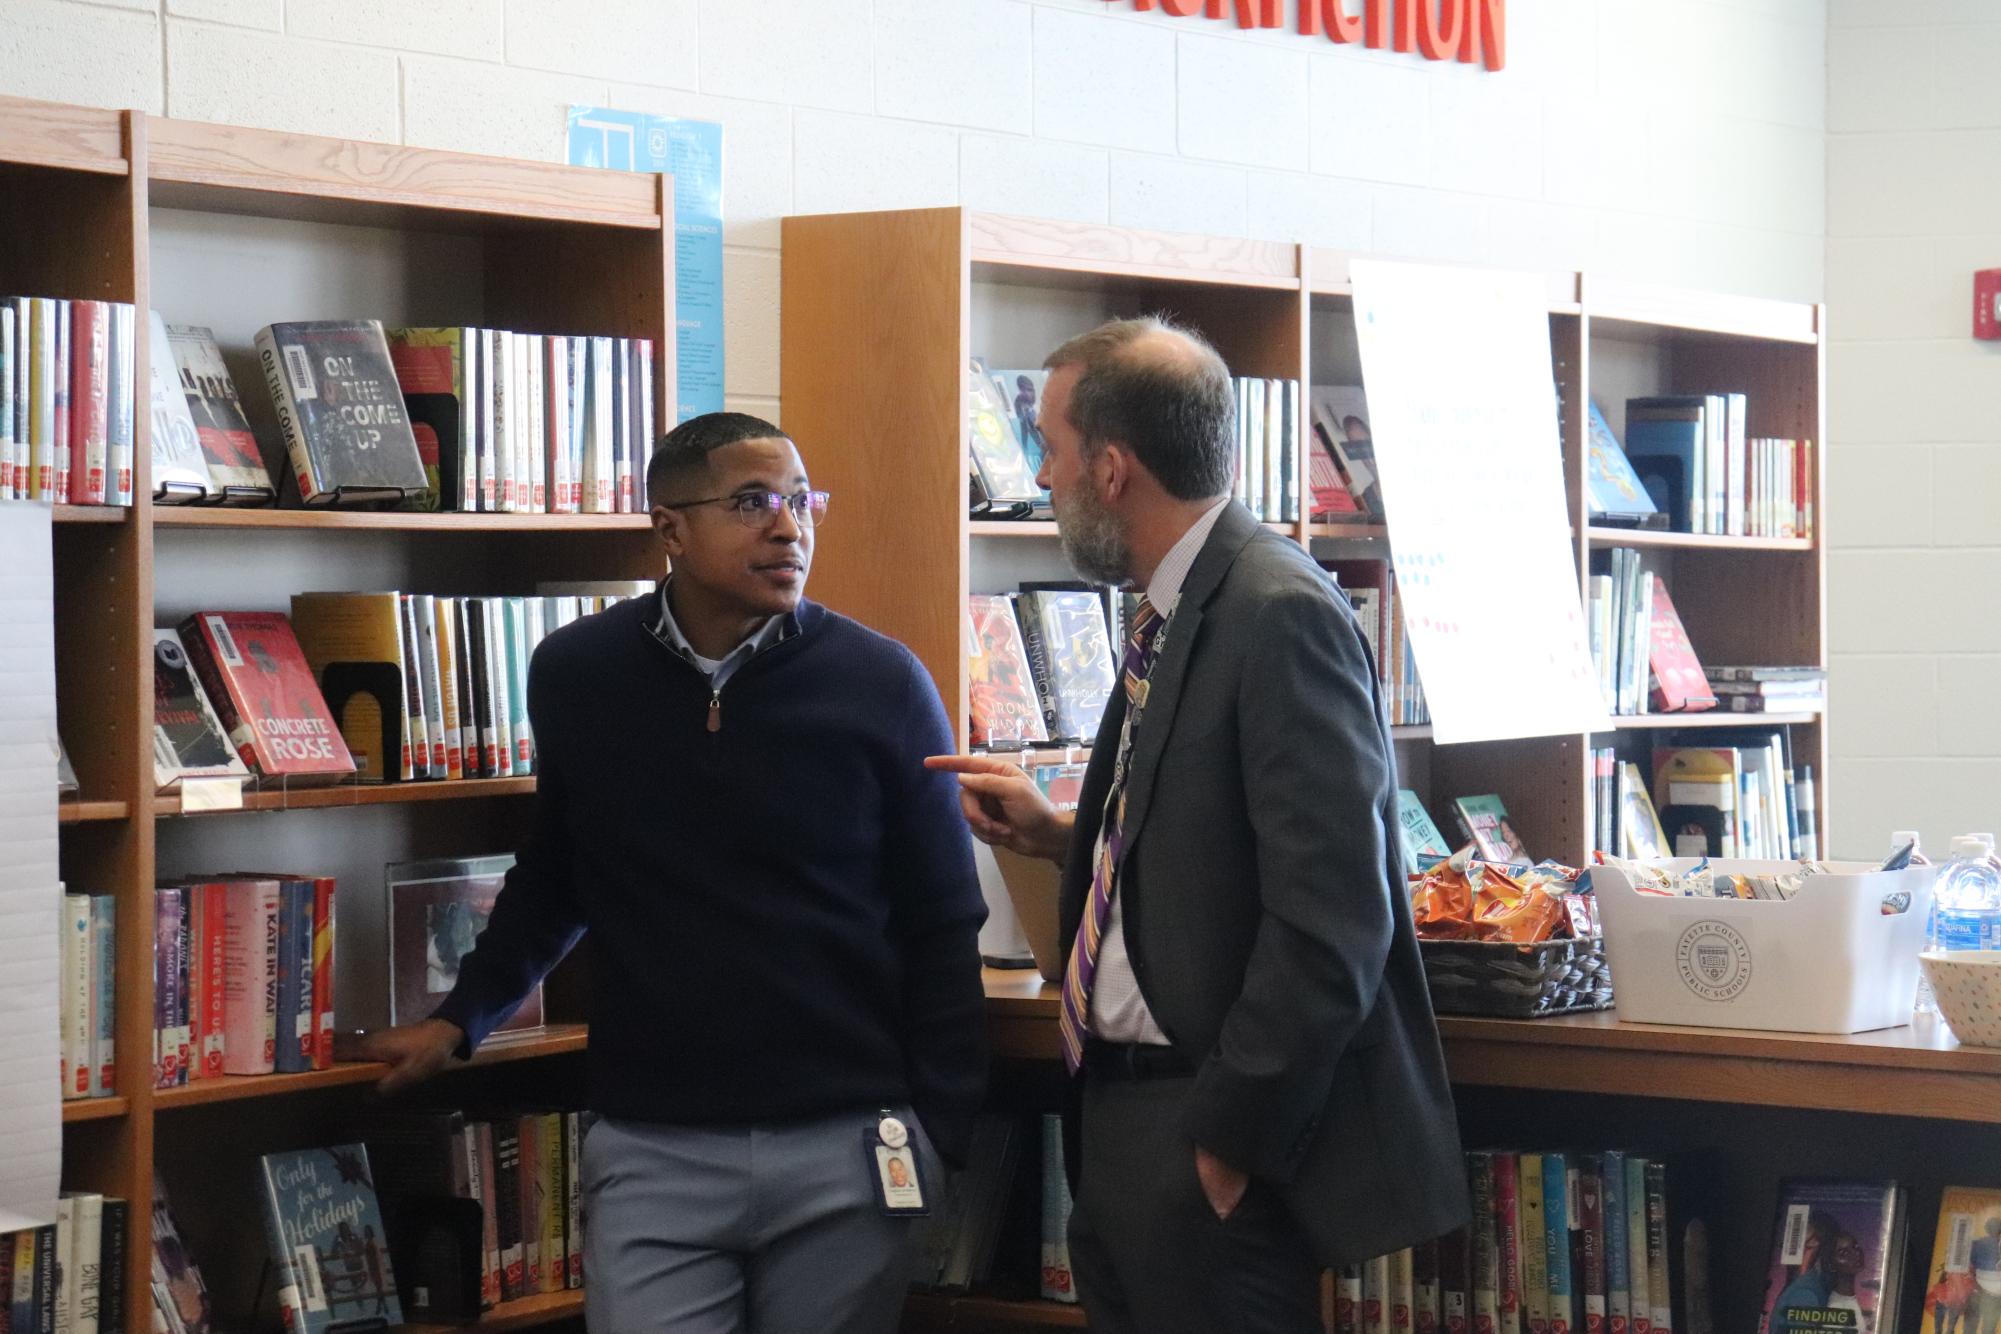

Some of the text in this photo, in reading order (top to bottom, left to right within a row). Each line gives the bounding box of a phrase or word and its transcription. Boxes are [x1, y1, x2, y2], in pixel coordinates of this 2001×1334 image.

[323, 356, 355, 377] ON
[261, 349, 298, 450] ON THE COME
[341, 380, 384, 402] THE
[340, 405, 402, 426] COME
[355, 430, 382, 450] UP
[1027, 631, 1049, 696] UNWHO
[257, 718, 331, 736] CONCRETE
[270, 737, 335, 760] ROSE
[266, 914, 277, 954] KATE
[1714, 925, 1748, 958] COUNTY
[212, 936, 222, 985] HERE'S
[266, 958, 276, 976] IN
[300, 957, 312, 1015] ICAR
[1681, 965, 1748, 997] PUBLIC SCHOOLS
[212, 992, 222, 1011] TO
[275, 1155, 318, 1191] Only
[297, 1181, 334, 1212] for the
[284, 1194, 367, 1247] Holidays
[1649, 1192, 1663, 1257] faking
[42, 1251, 52, 1304] UNIVERSAL
[79, 1263, 99, 1321] BONE GAP
[41, 1305, 51, 1333] LAWS
[1786, 1308, 1849, 1324] FINDING
